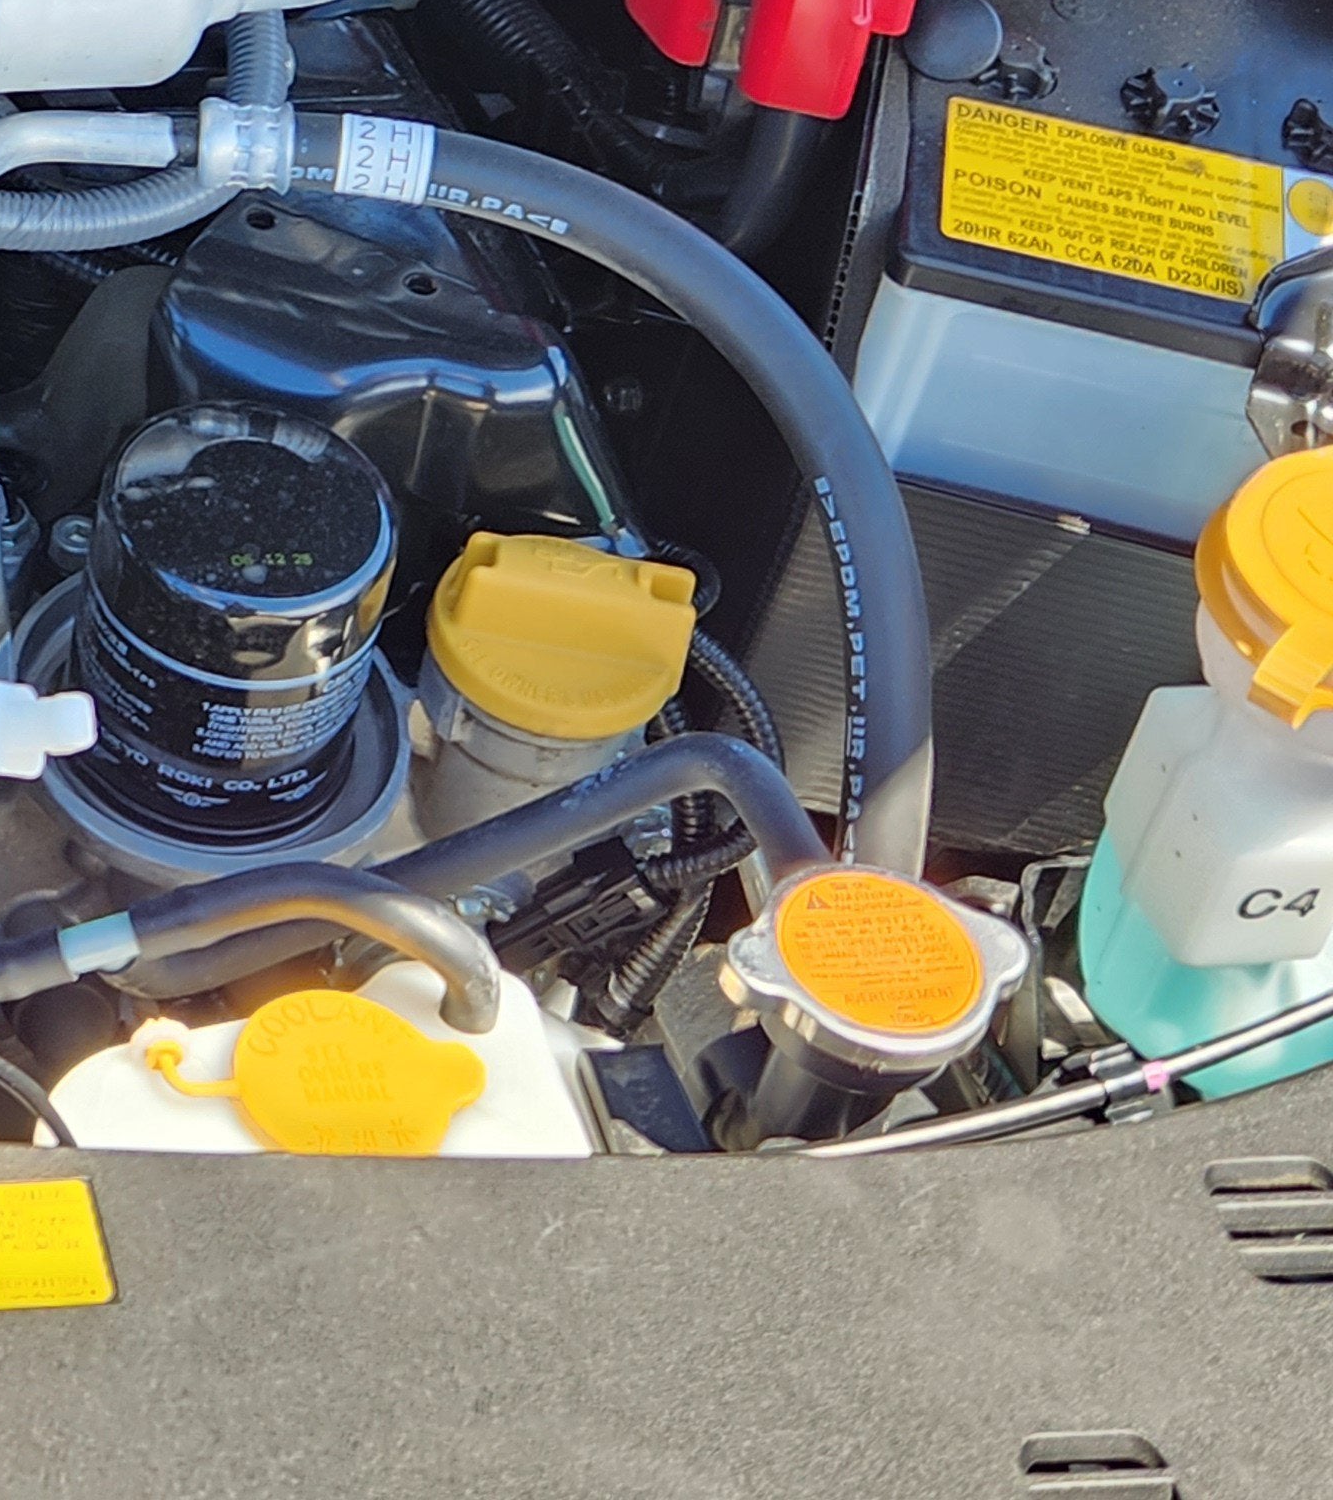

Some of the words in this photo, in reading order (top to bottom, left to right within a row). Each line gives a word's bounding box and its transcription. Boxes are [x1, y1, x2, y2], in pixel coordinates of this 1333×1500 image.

[957, 103, 1049, 135] DANGER
[1057, 126, 1127, 149] EXPLOSIVE
[1133, 142, 1176, 161] GASES
[953, 169, 1042, 199] POISON
[1056, 192, 1110, 214] CAUSES
[1113, 205, 1164, 226] SEVERE
[1169, 217, 1215, 238] BURNS
[1023, 168, 1057, 182] KEEP
[1062, 177, 1093, 193] VENT
[1098, 185, 1132, 201] CAPS
[1137, 192, 1175, 210] TIGHT
[1178, 202, 1206, 218] AND
[1209, 210, 1250, 229] LEVEL
[953, 219, 1001, 242] 20HR
[1007, 231, 1053, 254] 62Ah
[1065, 244, 1105, 266] CCA
[1111, 253, 1157, 278] 620A
[1168, 267, 1245, 298] D23(JIS)
[1020, 219, 1054, 233] KEEP
[1058, 226, 1083, 241] OUT
[1089, 233, 1104, 245] OF
[1110, 238, 1156, 257] REACH
[1160, 249, 1176, 262] OF
[1181, 255, 1248, 280] CHILDREN
[157, 762, 213, 789] ROKI
